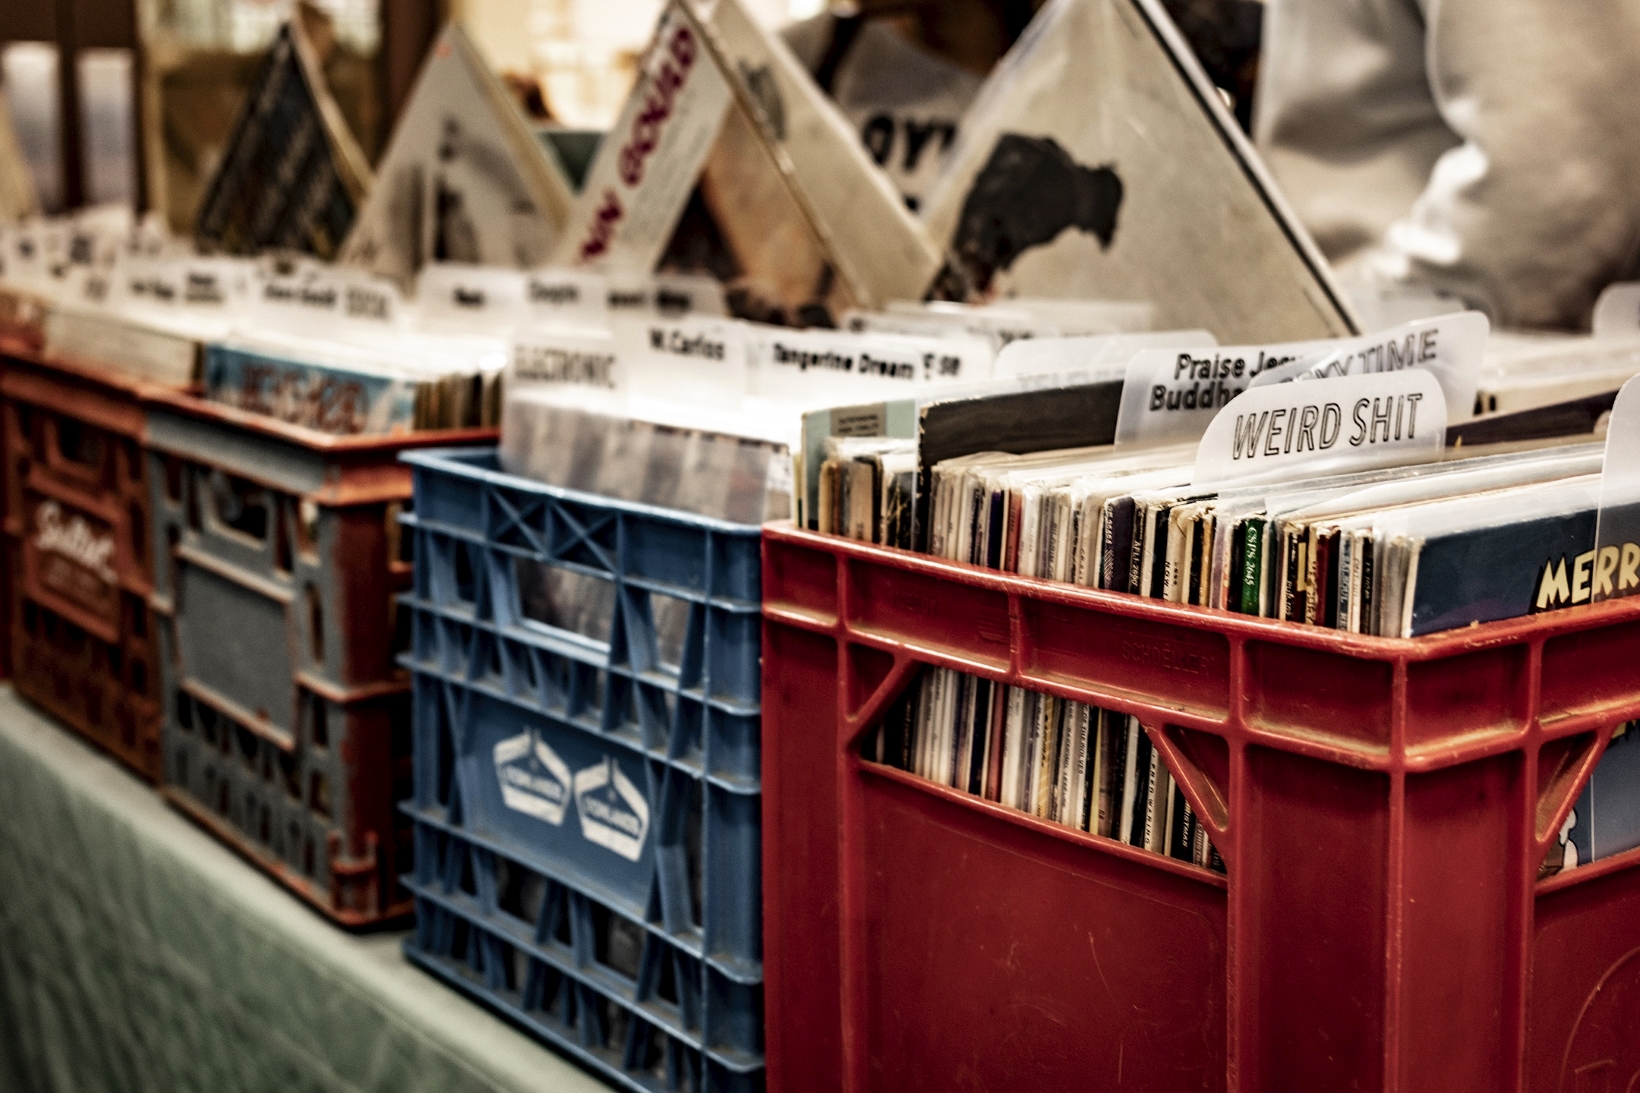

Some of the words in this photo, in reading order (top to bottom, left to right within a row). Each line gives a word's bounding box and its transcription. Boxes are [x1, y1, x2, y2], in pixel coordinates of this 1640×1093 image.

[773, 343, 854, 372] Tangerine
[858, 353, 914, 380] Dream
[1174, 353, 1245, 382] Praise
[1358, 328, 1439, 374] TIME
[1232, 402, 1342, 460] WEIRD
[1349, 393, 1423, 447] SHIT
[1246, 526, 1257, 559] CSPS
[1144, 799, 1153, 844] WARING
